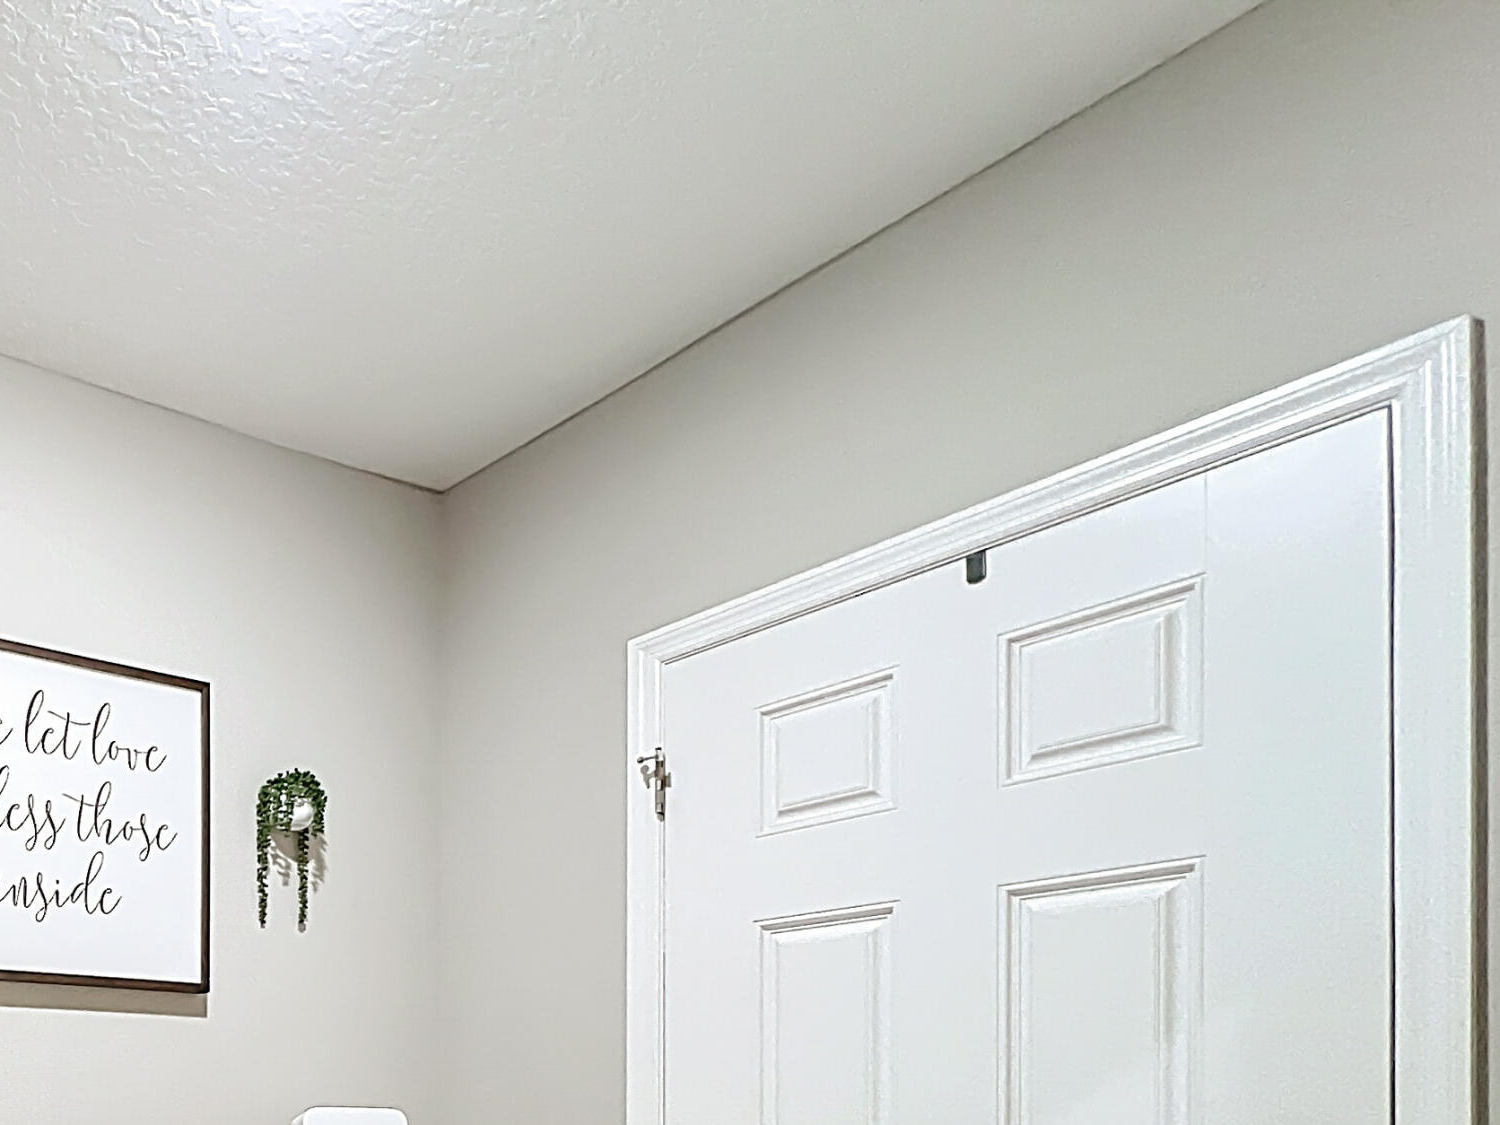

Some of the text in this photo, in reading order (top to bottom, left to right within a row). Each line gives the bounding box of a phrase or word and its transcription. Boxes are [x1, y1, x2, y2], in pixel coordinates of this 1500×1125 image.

[23, 689, 91, 760] let
[92, 703, 167, 776] love
[62, 781, 178, 862] those
